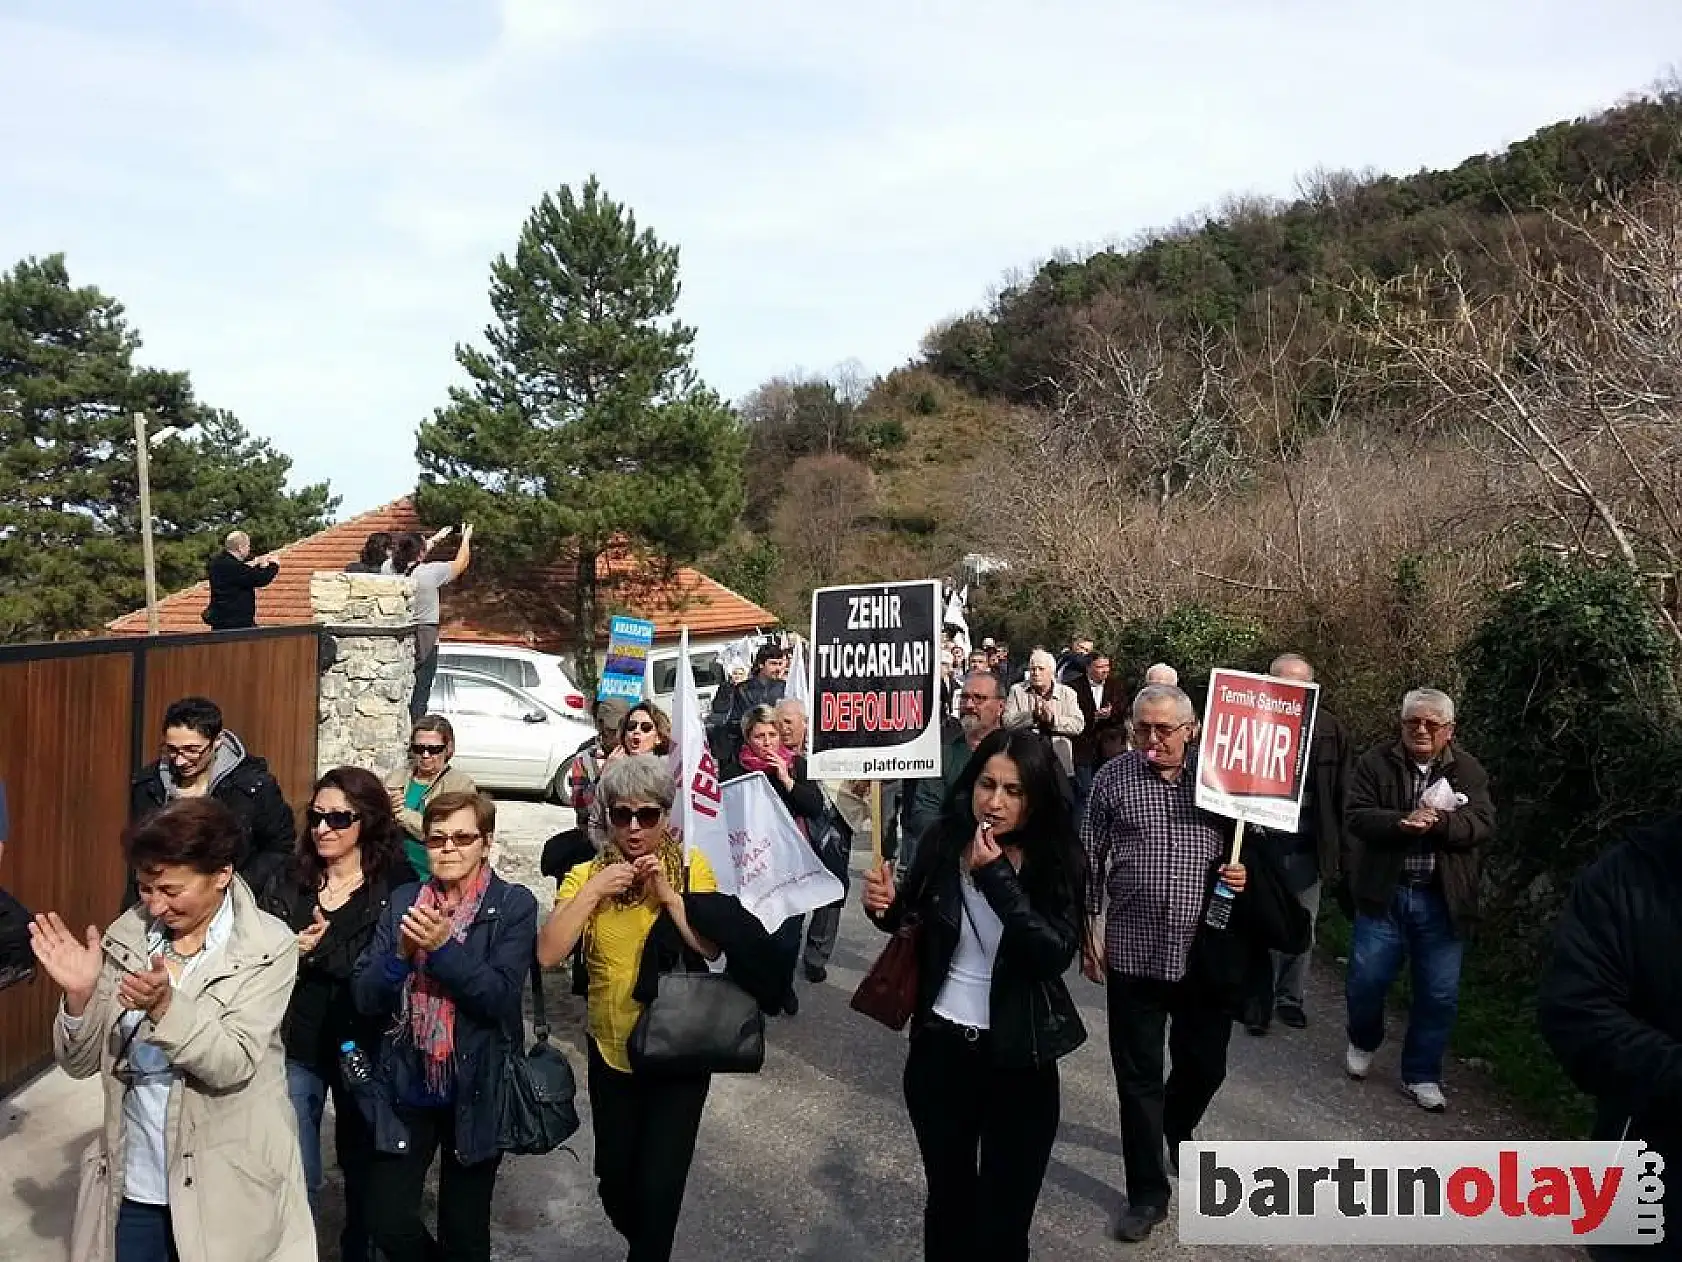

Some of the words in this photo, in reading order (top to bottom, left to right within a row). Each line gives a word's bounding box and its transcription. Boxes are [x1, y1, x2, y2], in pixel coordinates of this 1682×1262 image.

[847, 588, 903, 631] ZEHİR
[818, 637, 929, 679] TÜCCARLARI
[820, 690, 924, 732] DEFOLUN
[1220, 684, 1257, 709] Termik
[1258, 691, 1303, 717] Santrale
[1211, 712, 1292, 783] HAYIR
